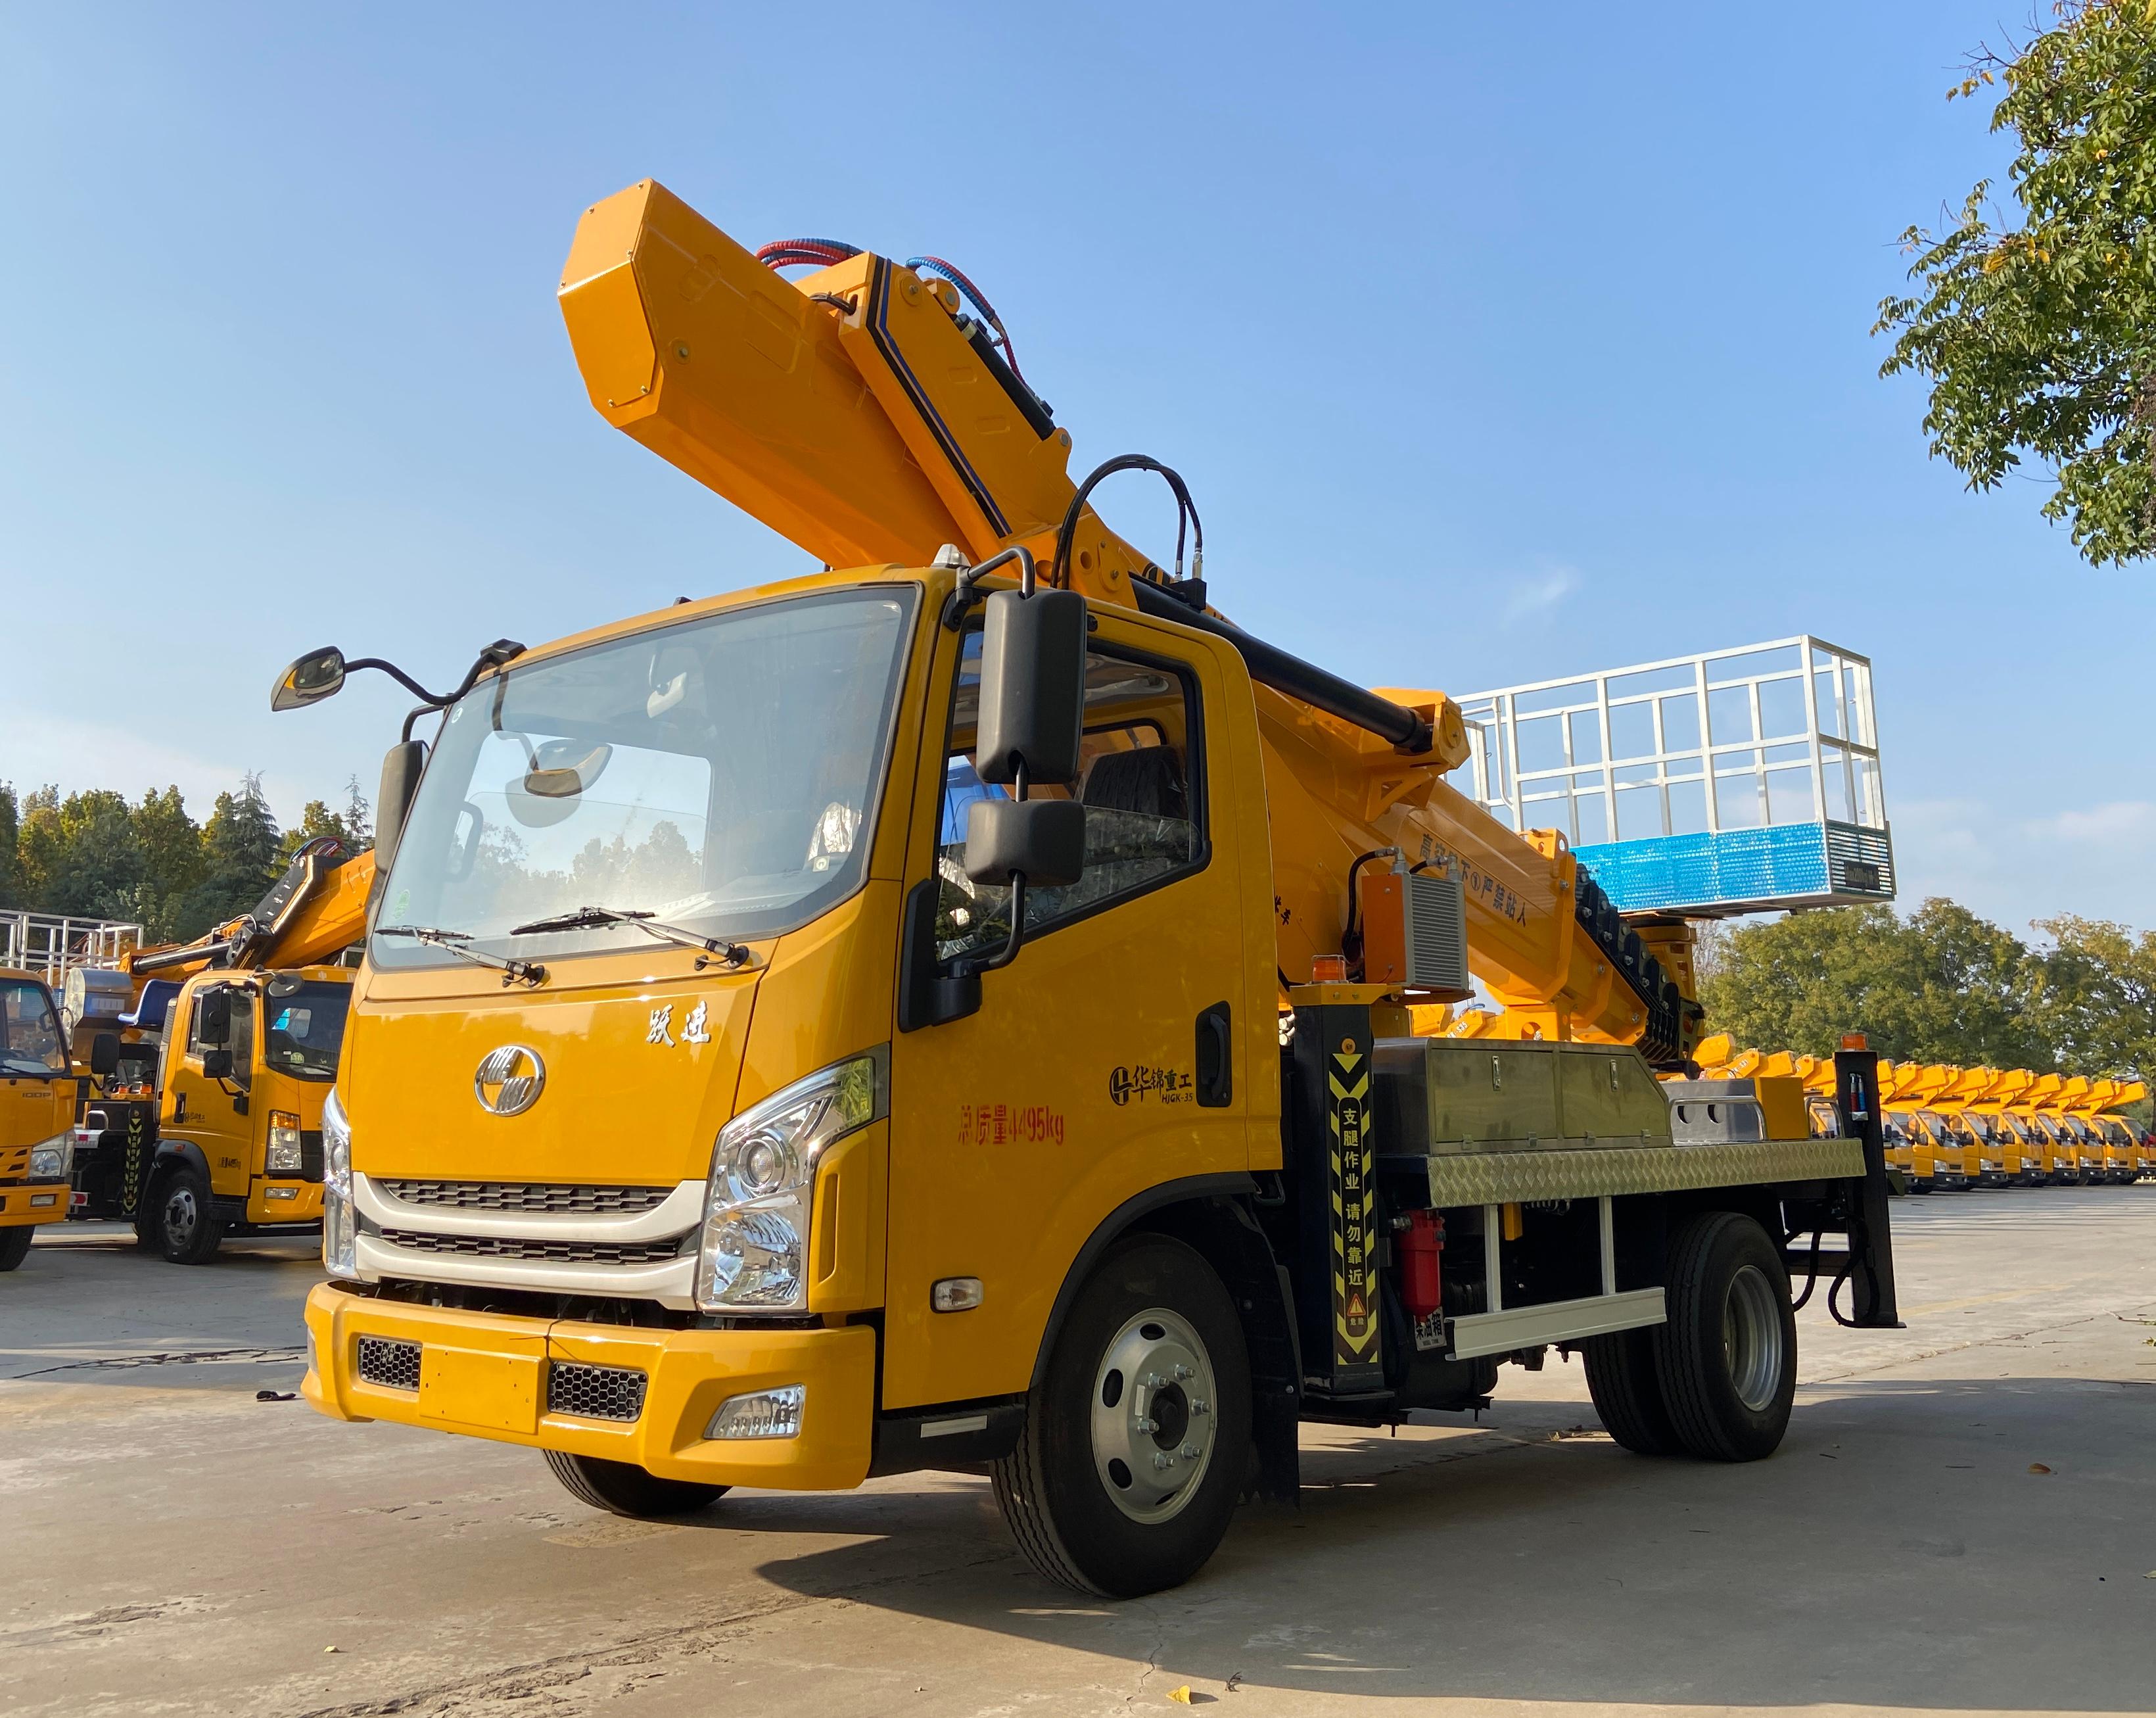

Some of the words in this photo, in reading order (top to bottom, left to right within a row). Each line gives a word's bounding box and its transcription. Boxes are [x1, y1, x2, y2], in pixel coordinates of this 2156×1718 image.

[1481, 875, 1526, 928] 严禁站人
[646, 1000, 711, 1047] 跃进
[1131, 1065, 1192, 1102] 华锦重工
[1161, 1093, 1193, 1104] HJGK-35
[1344, 1109, 1360, 1190] 支腿作业
[1346, 1203, 1363, 1286] 请勿靠近
